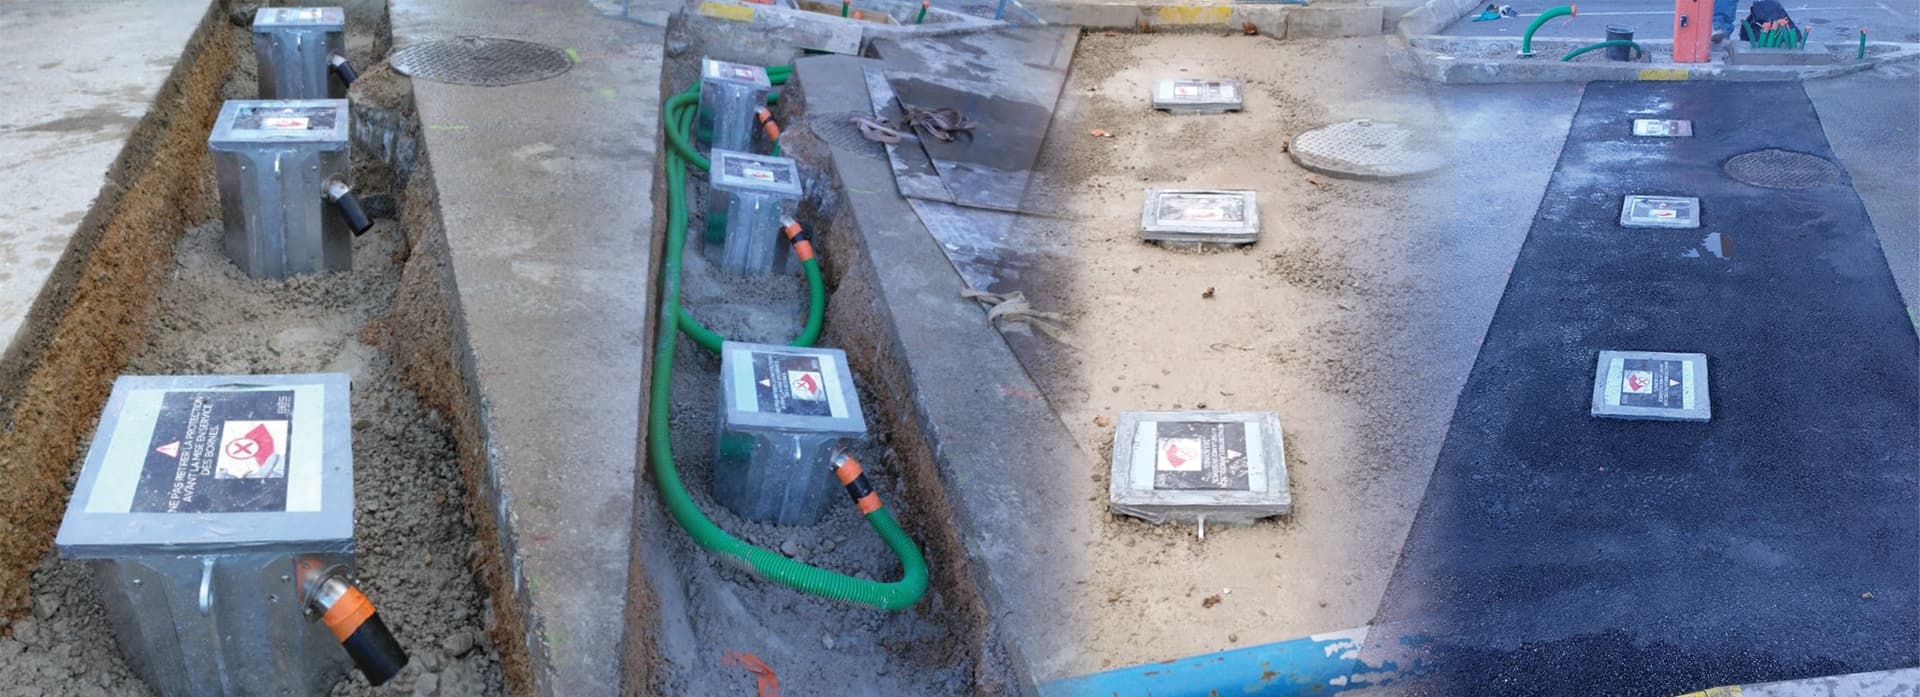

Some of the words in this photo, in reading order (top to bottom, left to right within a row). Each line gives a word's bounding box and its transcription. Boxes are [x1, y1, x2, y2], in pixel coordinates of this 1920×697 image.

[186, 396, 202, 440] PROTECTION
[200, 404, 212, 430] SERVICE
[184, 440, 193, 450] LA
[196, 431, 205, 442] EN
[193, 442, 204, 460] MISE
[190, 461, 200, 472] LA
[201, 459, 212, 476] DES
[171, 482, 184, 500] PAS
[182, 473, 196, 502] AVANT
[168, 500, 180, 512] NE
